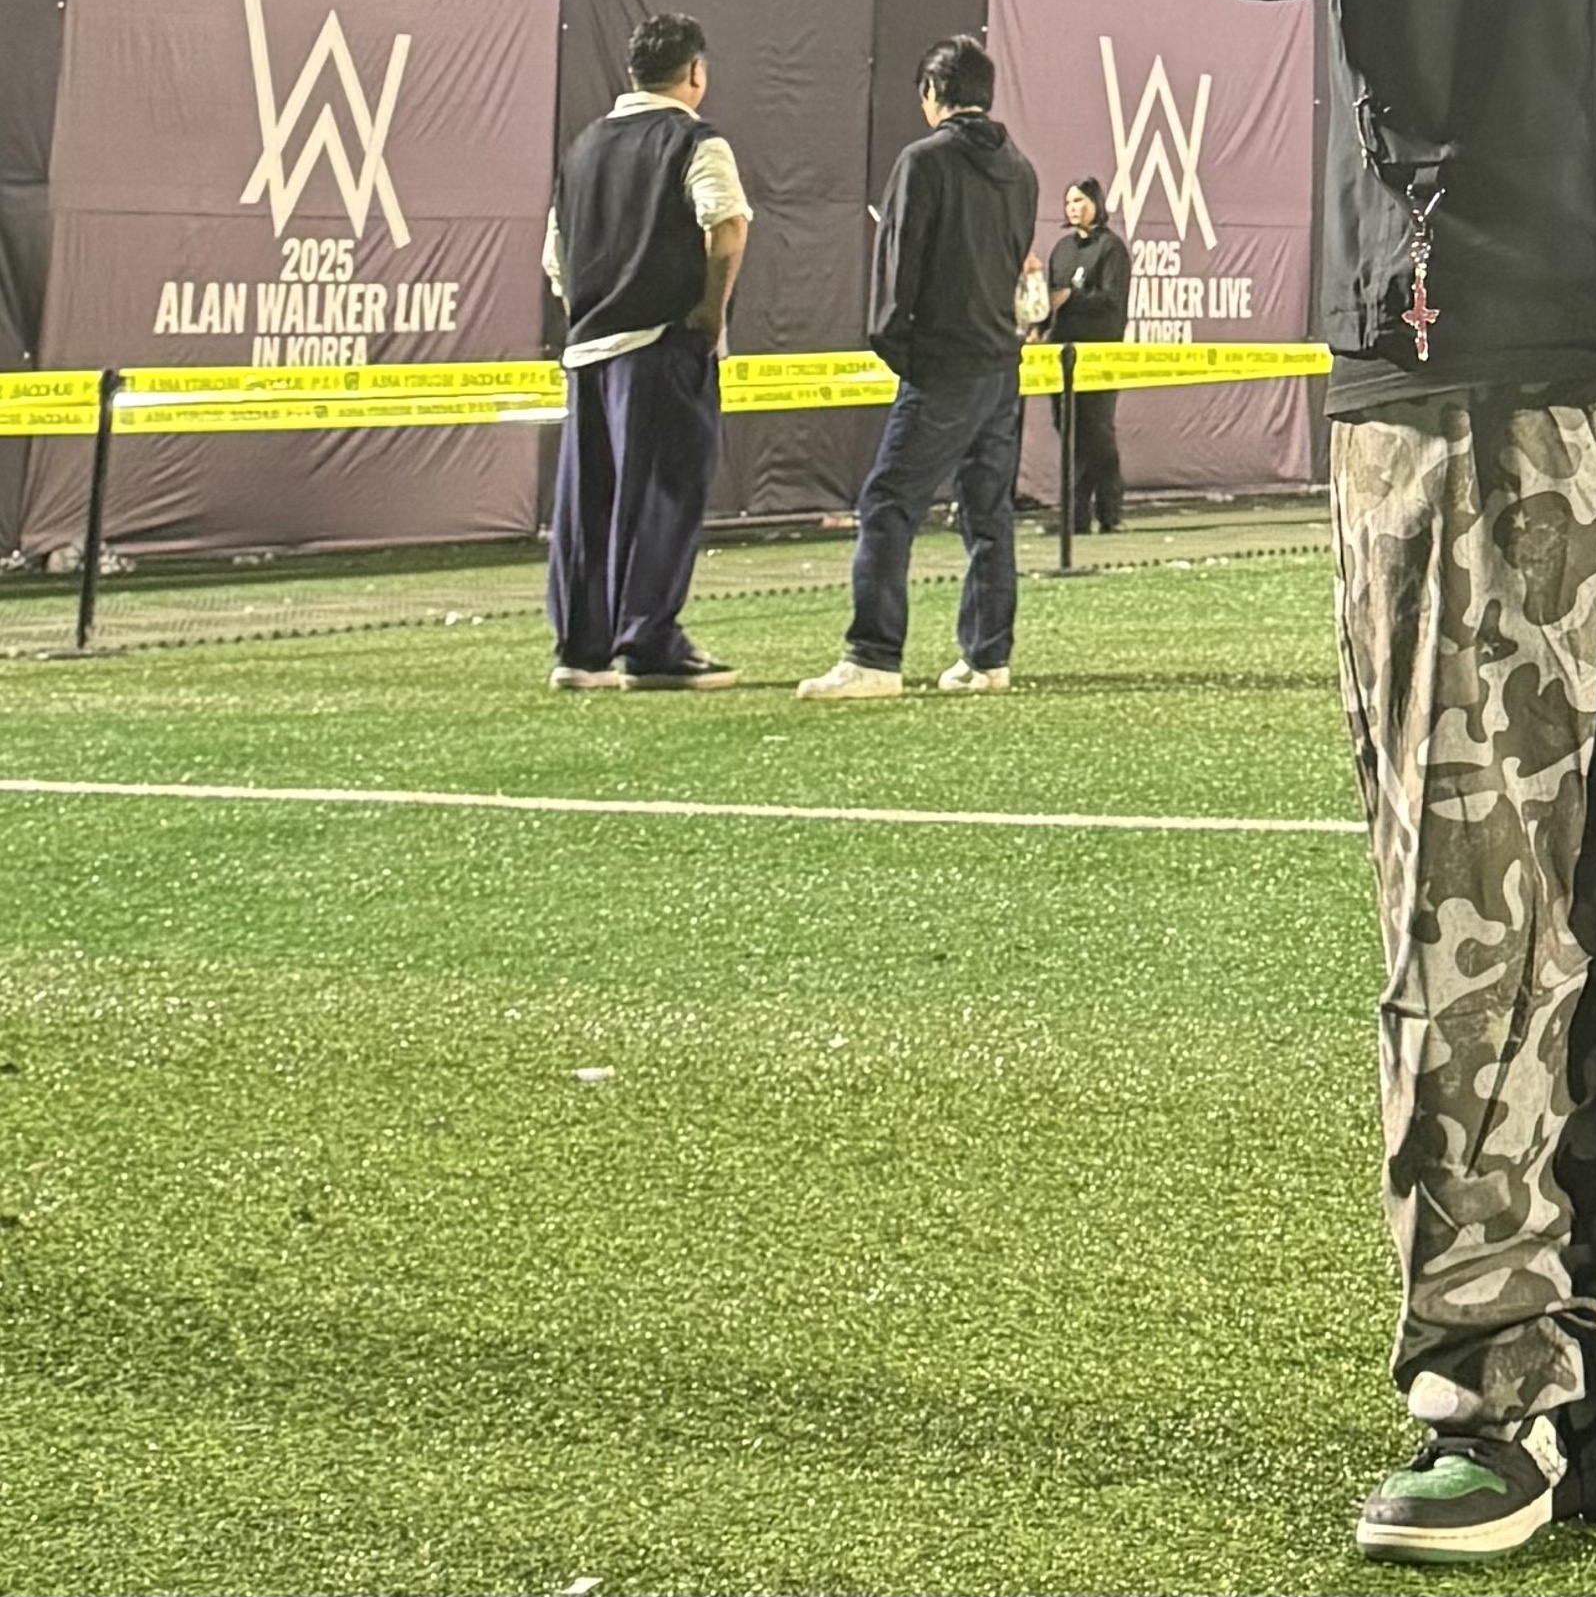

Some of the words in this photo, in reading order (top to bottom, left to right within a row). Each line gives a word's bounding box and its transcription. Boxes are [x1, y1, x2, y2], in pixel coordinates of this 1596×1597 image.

[280, 237, 355, 282] 2025
[1131, 239, 1181, 276] 2025
[153, 281, 247, 334] ALAN
[257, 282, 388, 334] WALKER
[394, 282, 460, 332] LIVE
[1208, 277, 1252, 318] LIVE
[252, 336, 280, 367] IN
[286, 335, 368, 367] KOREA
